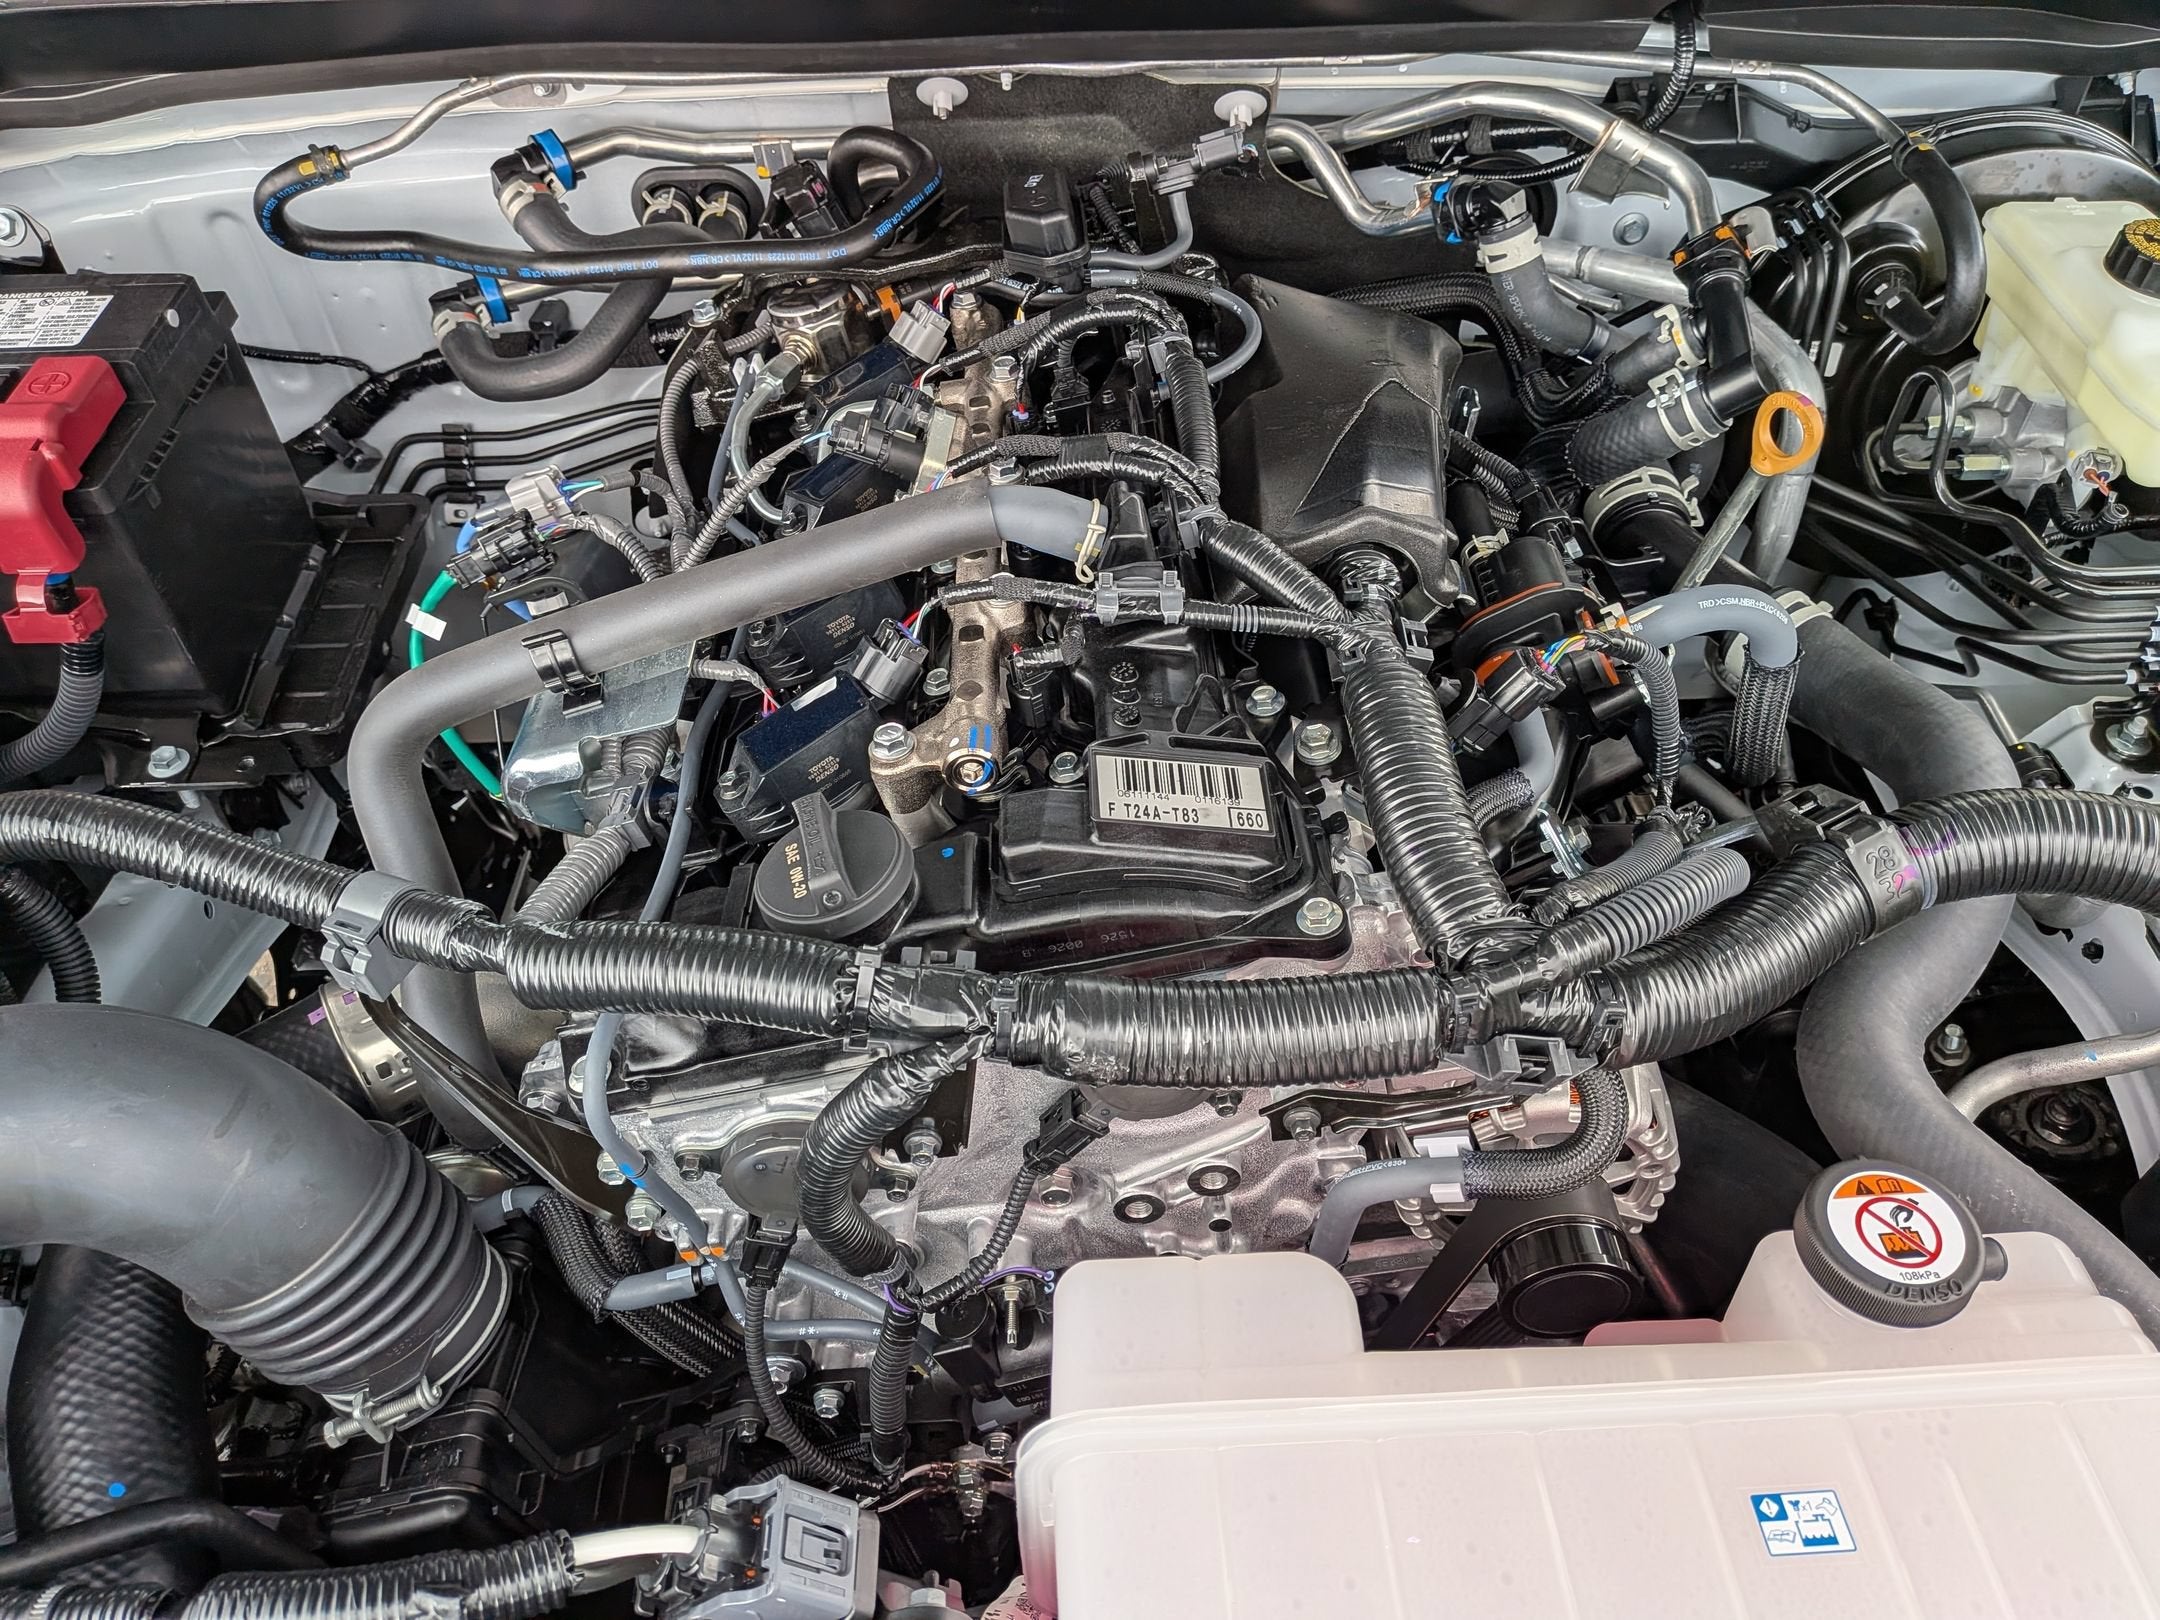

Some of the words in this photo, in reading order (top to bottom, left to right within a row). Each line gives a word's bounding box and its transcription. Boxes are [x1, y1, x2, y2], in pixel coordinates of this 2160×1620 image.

[767, 252, 796, 262] 011225
[826, 247, 848, 259] DOT
[640, 260, 659, 270] DOT
[808, 755, 834, 771] TOYOTA
[815, 763, 839, 783] DENSO
[1108, 802, 1116, 817] F
[1124, 803, 1199, 824] T24A-T83
[1237, 811, 1264, 829] 660
[784, 842, 801, 865] SAE
[1899, 1270, 1941, 1282] 108kPa
[1885, 1279, 1964, 1303] DENSO
